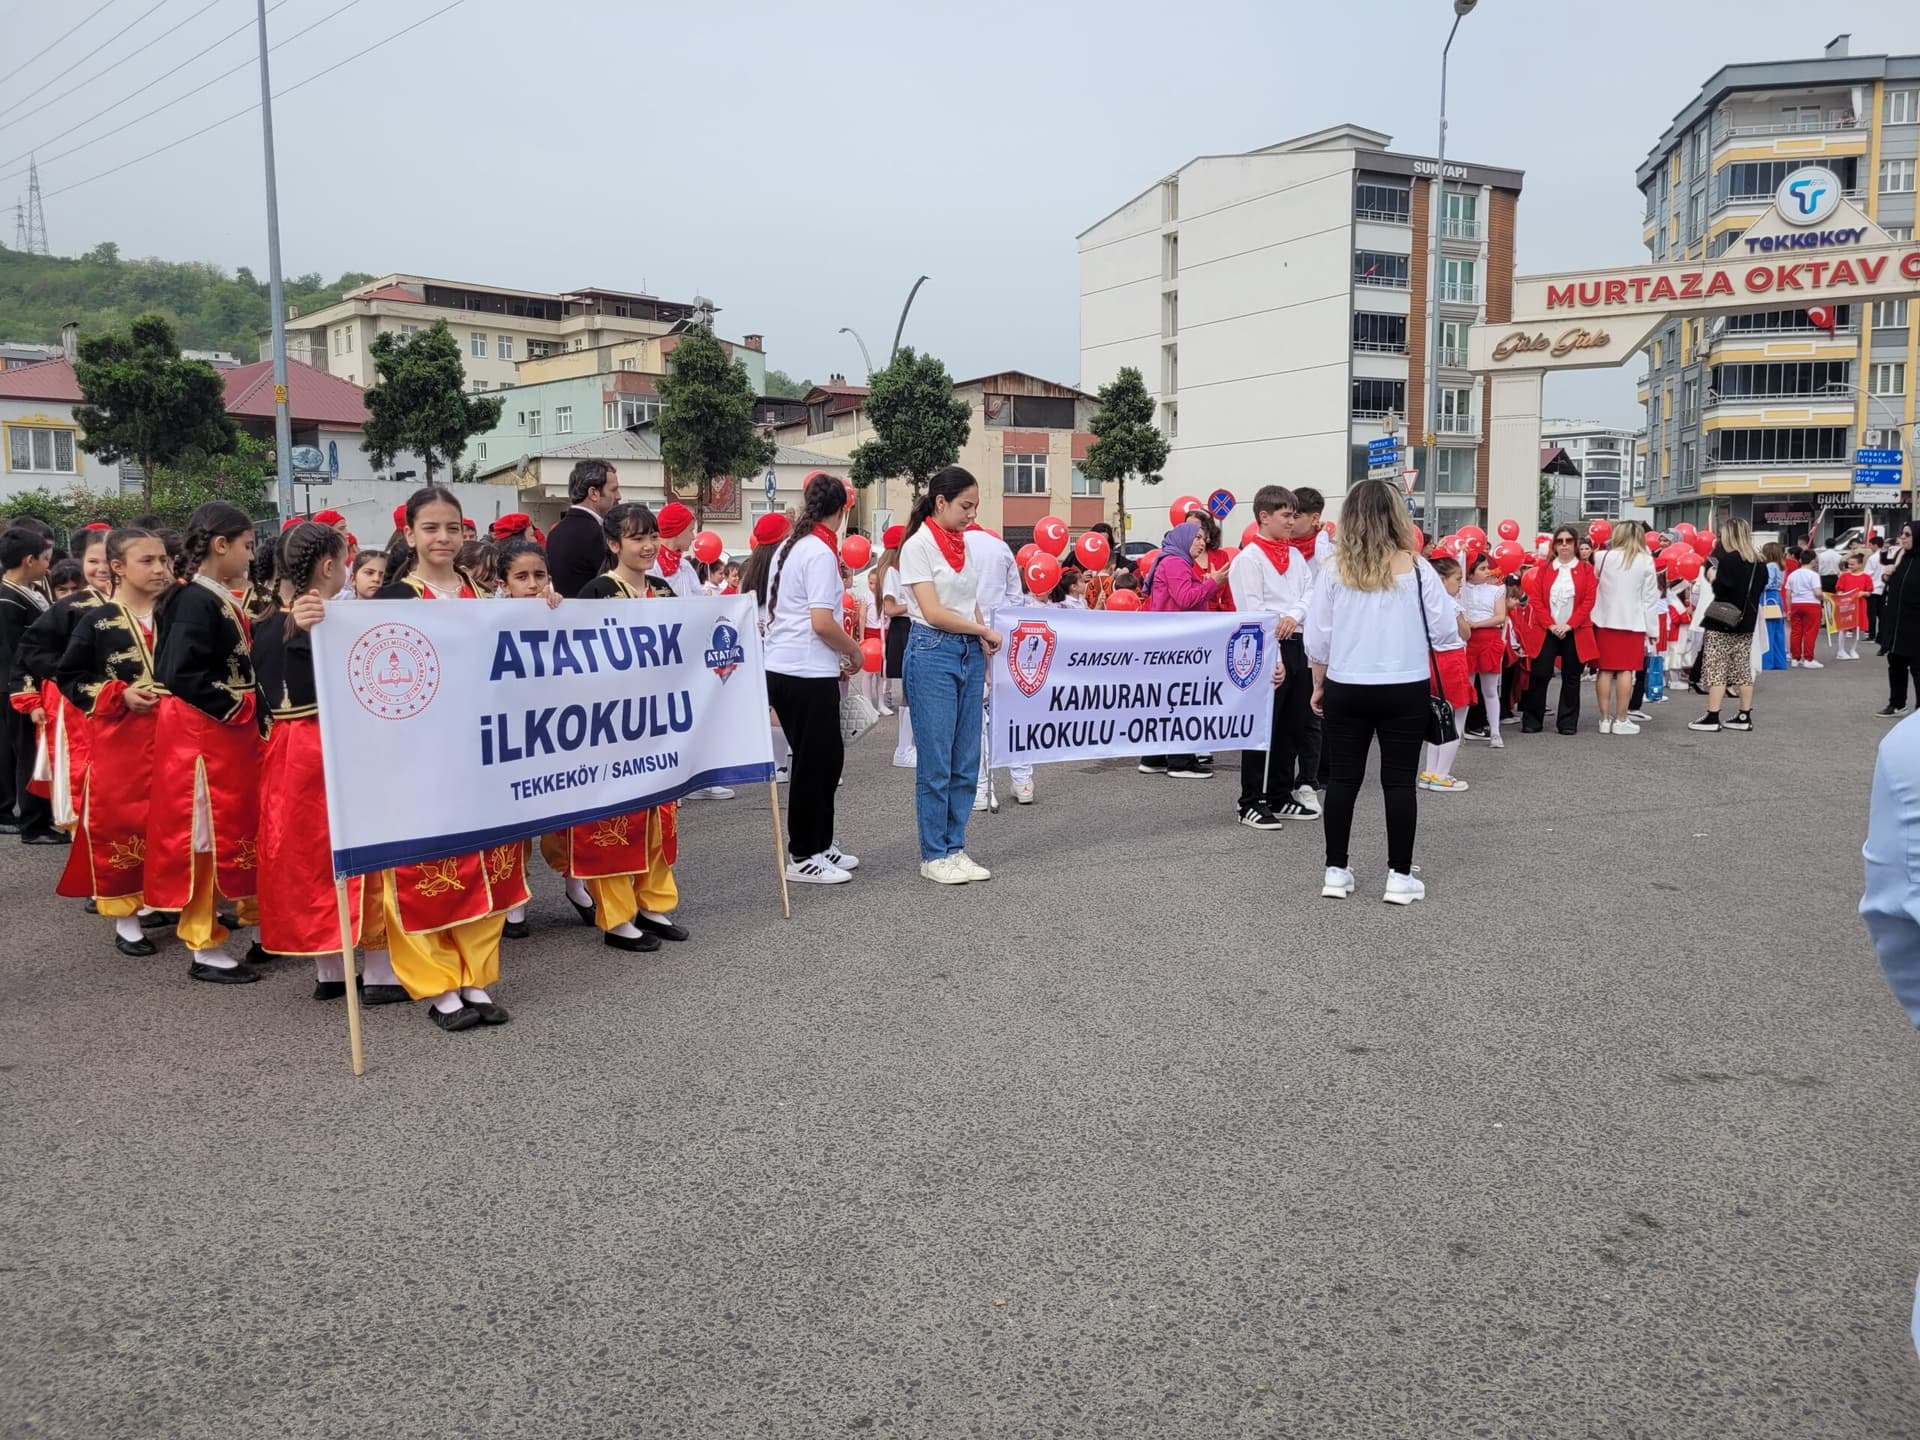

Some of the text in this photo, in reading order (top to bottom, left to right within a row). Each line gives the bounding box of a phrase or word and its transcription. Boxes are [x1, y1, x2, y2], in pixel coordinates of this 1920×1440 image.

[1546, 271, 1735, 309] MURTAZA
[1745, 256, 1888, 293] OKTAV
[1856, 469, 1880, 477] Sinop
[489, 617, 684, 681] ATATÜRK
[707, 647, 741, 662] ATATK
[1067, 651, 1131, 667] SAMSUN
[1143, 647, 1212, 666] TEKKEKÖY
[1049, 676, 1225, 713] KAMURAN ÇELİK
[510, 762, 599, 801] TEKKEKÖY
[611, 751, 680, 779] SAMSUN
